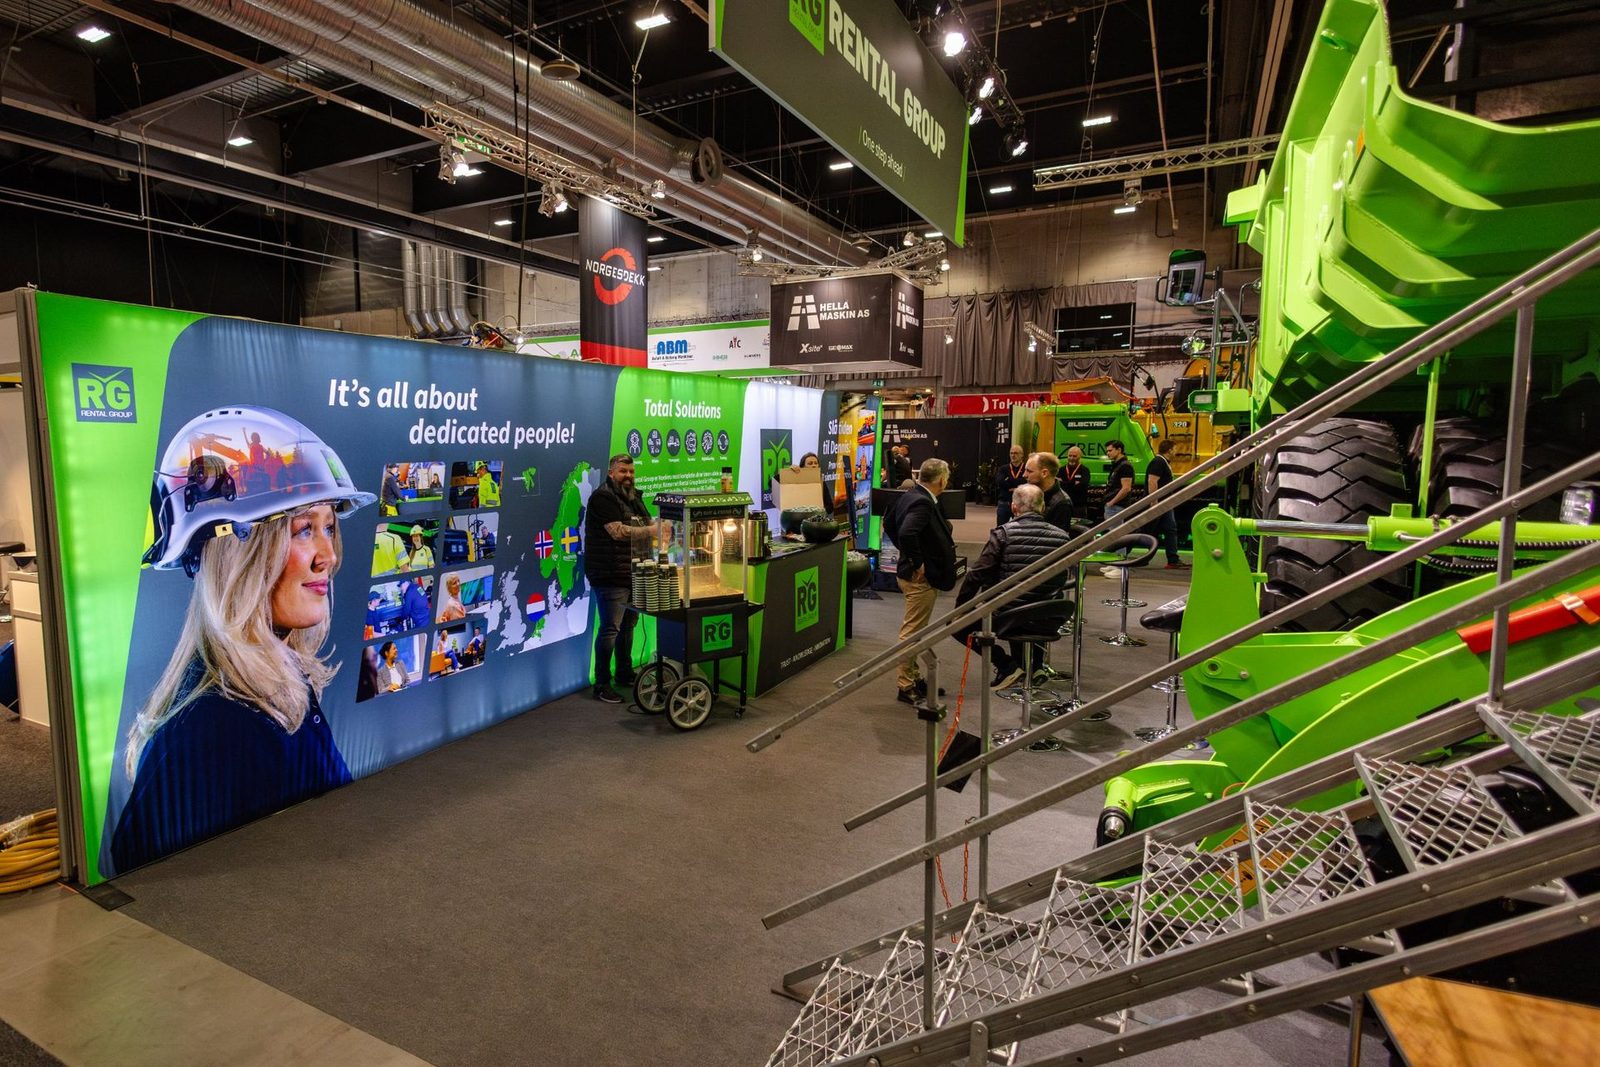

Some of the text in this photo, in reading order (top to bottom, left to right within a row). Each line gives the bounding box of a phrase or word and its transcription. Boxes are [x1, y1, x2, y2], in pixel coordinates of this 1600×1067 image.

[829, 0, 946, 160] RENTAL GROUP
[862, 129, 903, 178] One step ahead
[585, 258, 645, 287] NORGESDEKK
[819, 301, 849, 312] HELLA
[819, 309, 870, 321] MASKIN AS
[656, 339, 688, 355] ABM
[78, 377, 131, 410] RG
[376, 381, 409, 409] all
[413, 383, 478, 411] about
[644, 399, 721, 419] Total Solutions
[409, 418, 575, 449] dedicated people!
[798, 582, 817, 617] RG
[704, 622, 731, 643] RG
